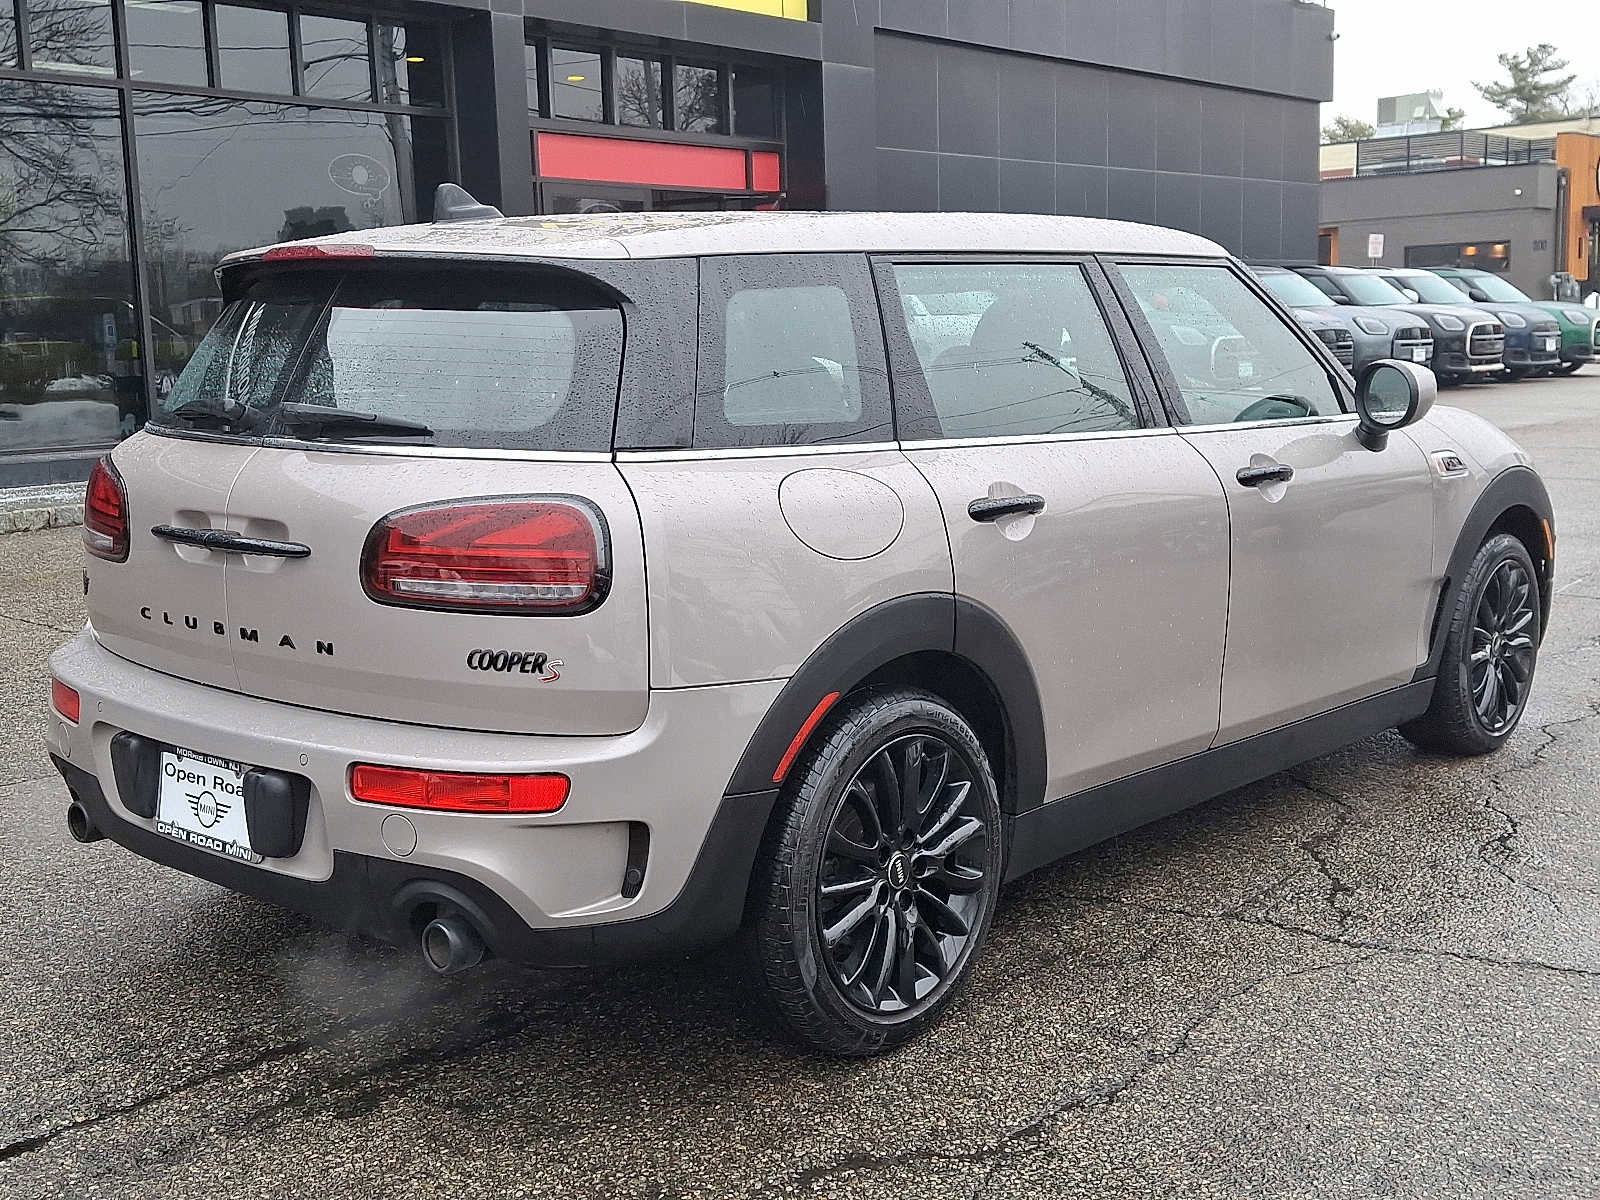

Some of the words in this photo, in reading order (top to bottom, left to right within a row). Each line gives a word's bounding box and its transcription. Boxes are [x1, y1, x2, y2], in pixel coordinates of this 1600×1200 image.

[140, 606, 334, 656] CLUBMAN
[466, 648, 548, 675] COOPER
[537, 659, 564, 684] S
[164, 762, 207, 787] Open
[212, 774, 244, 798] Roa
[228, 761, 240, 771] NJ
[199, 803, 216, 816] MINI
[157, 822, 187, 841] OPEN
[189, 832, 223, 851] ROAD
[225, 842, 252, 861] MINI
[895, 859, 905, 884] MINI
